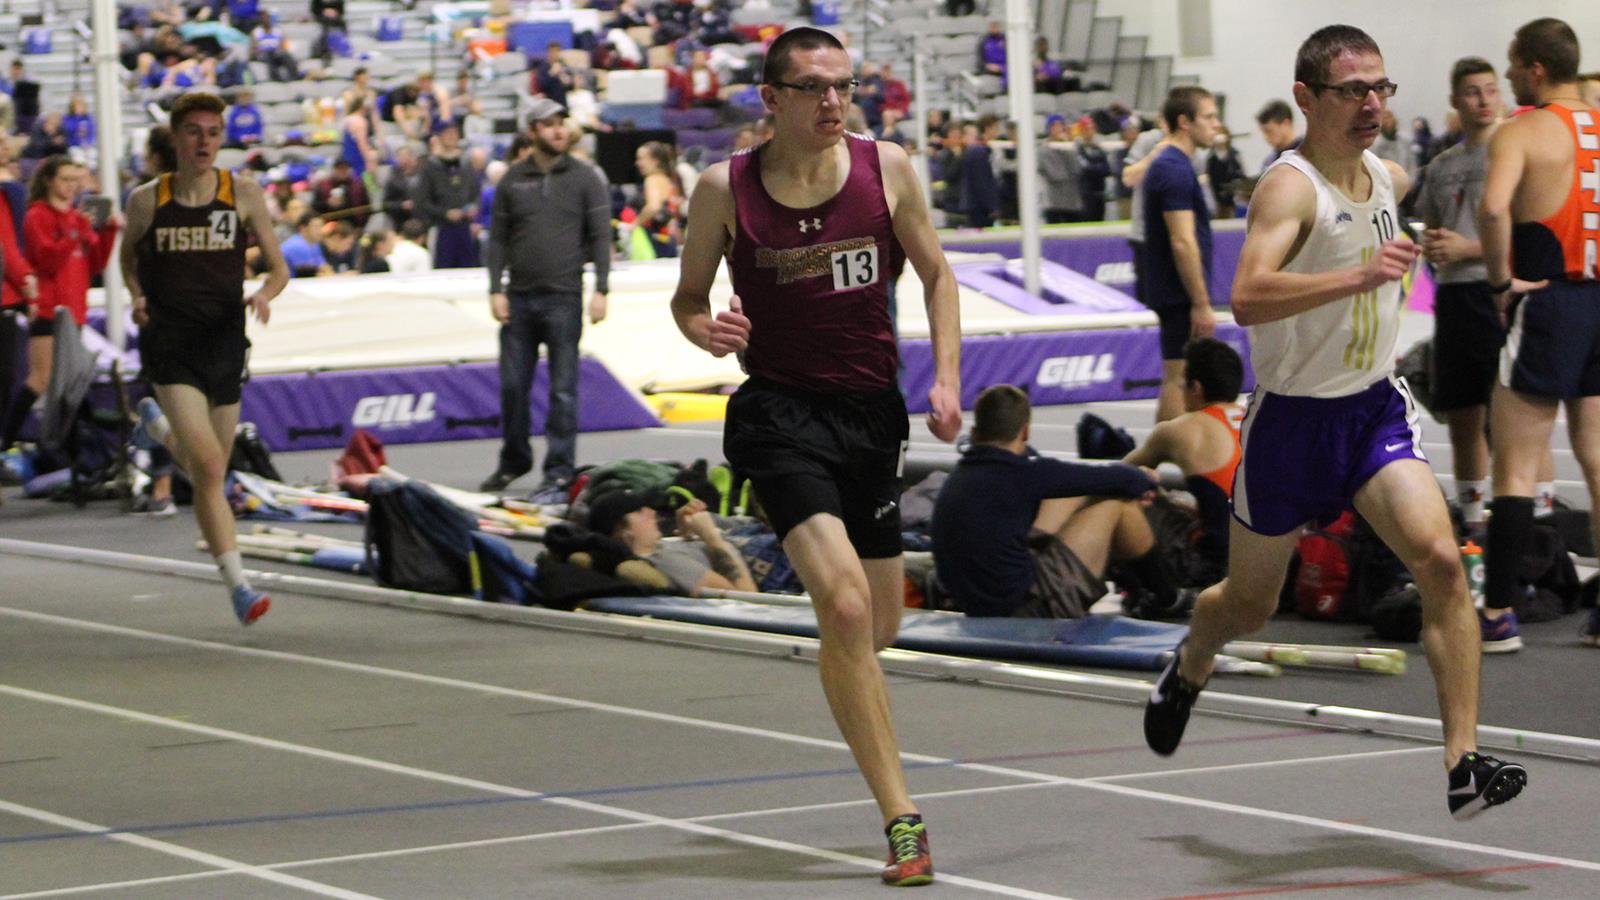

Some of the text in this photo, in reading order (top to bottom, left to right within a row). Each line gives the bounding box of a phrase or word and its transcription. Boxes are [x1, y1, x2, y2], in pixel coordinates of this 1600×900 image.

[155, 226, 235, 252] FISHE
[215, 212, 231, 239] 4
[1372, 209, 1393, 244] 10
[835, 250, 873, 287] 13
[1094, 261, 1138, 284] GIL
[1036, 353, 1113, 388] GILL
[352, 392, 436, 427] GILL
